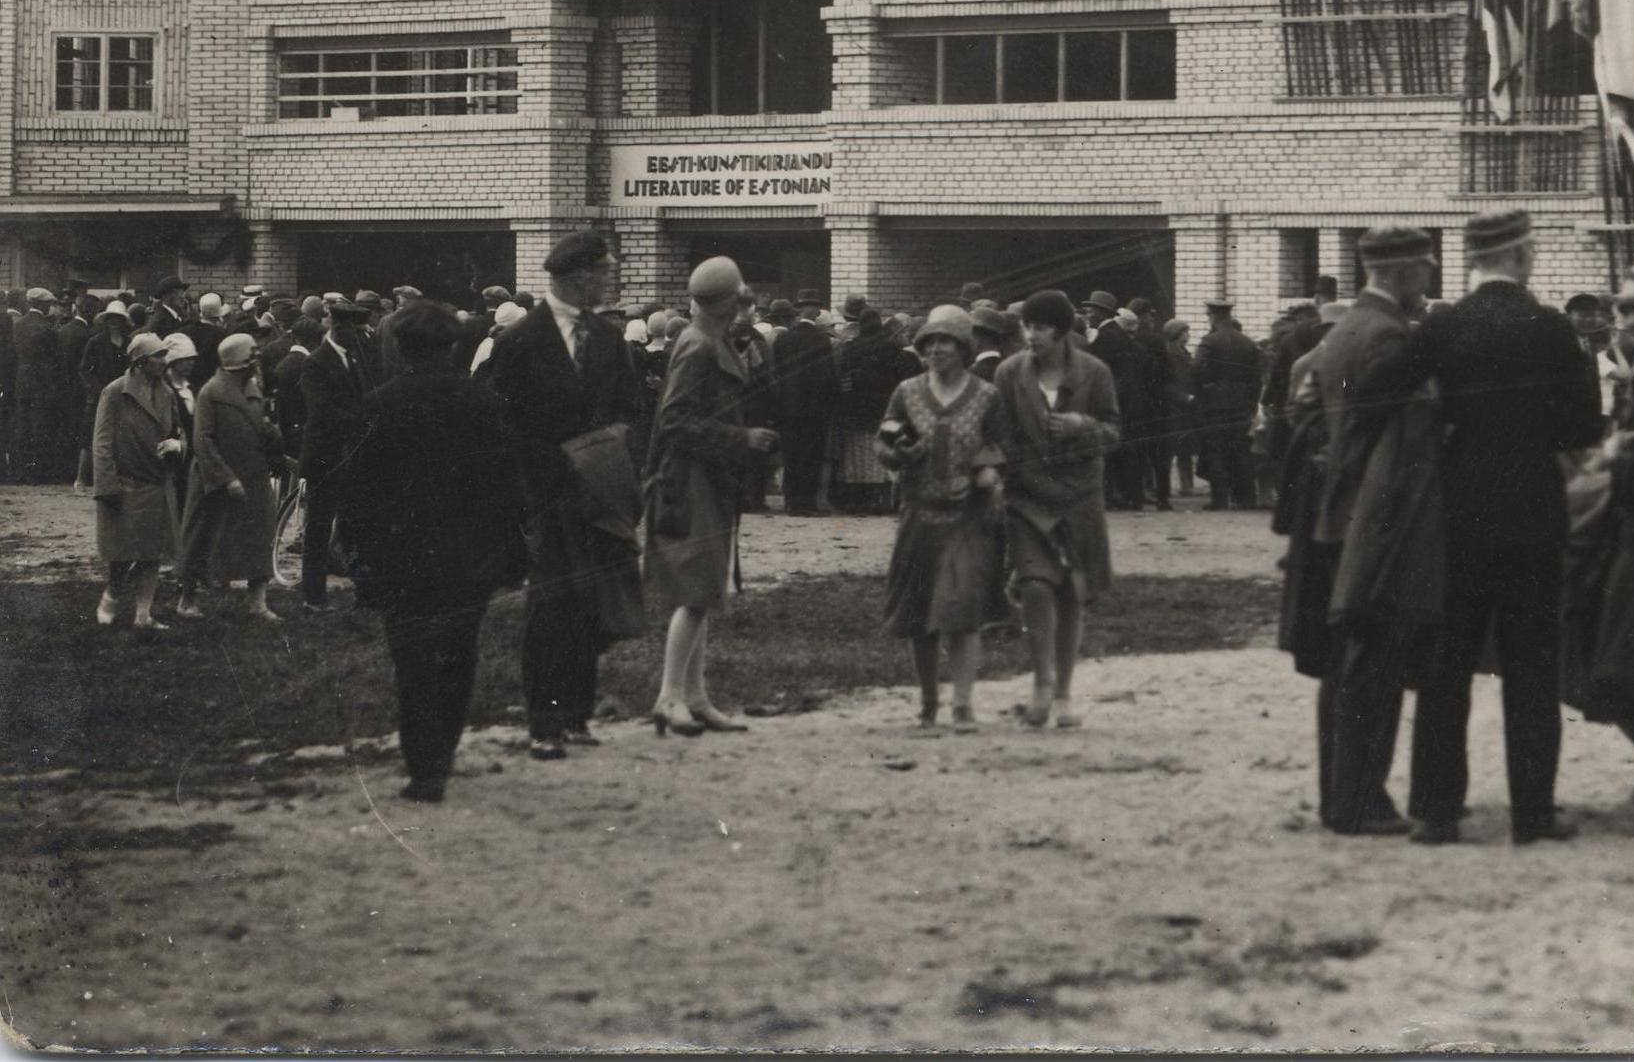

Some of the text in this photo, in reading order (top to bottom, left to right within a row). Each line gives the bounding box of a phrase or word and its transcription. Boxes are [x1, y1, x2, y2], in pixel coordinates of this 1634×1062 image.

[623, 177, 831, 197] LITERATURE OF ESTONIAN
